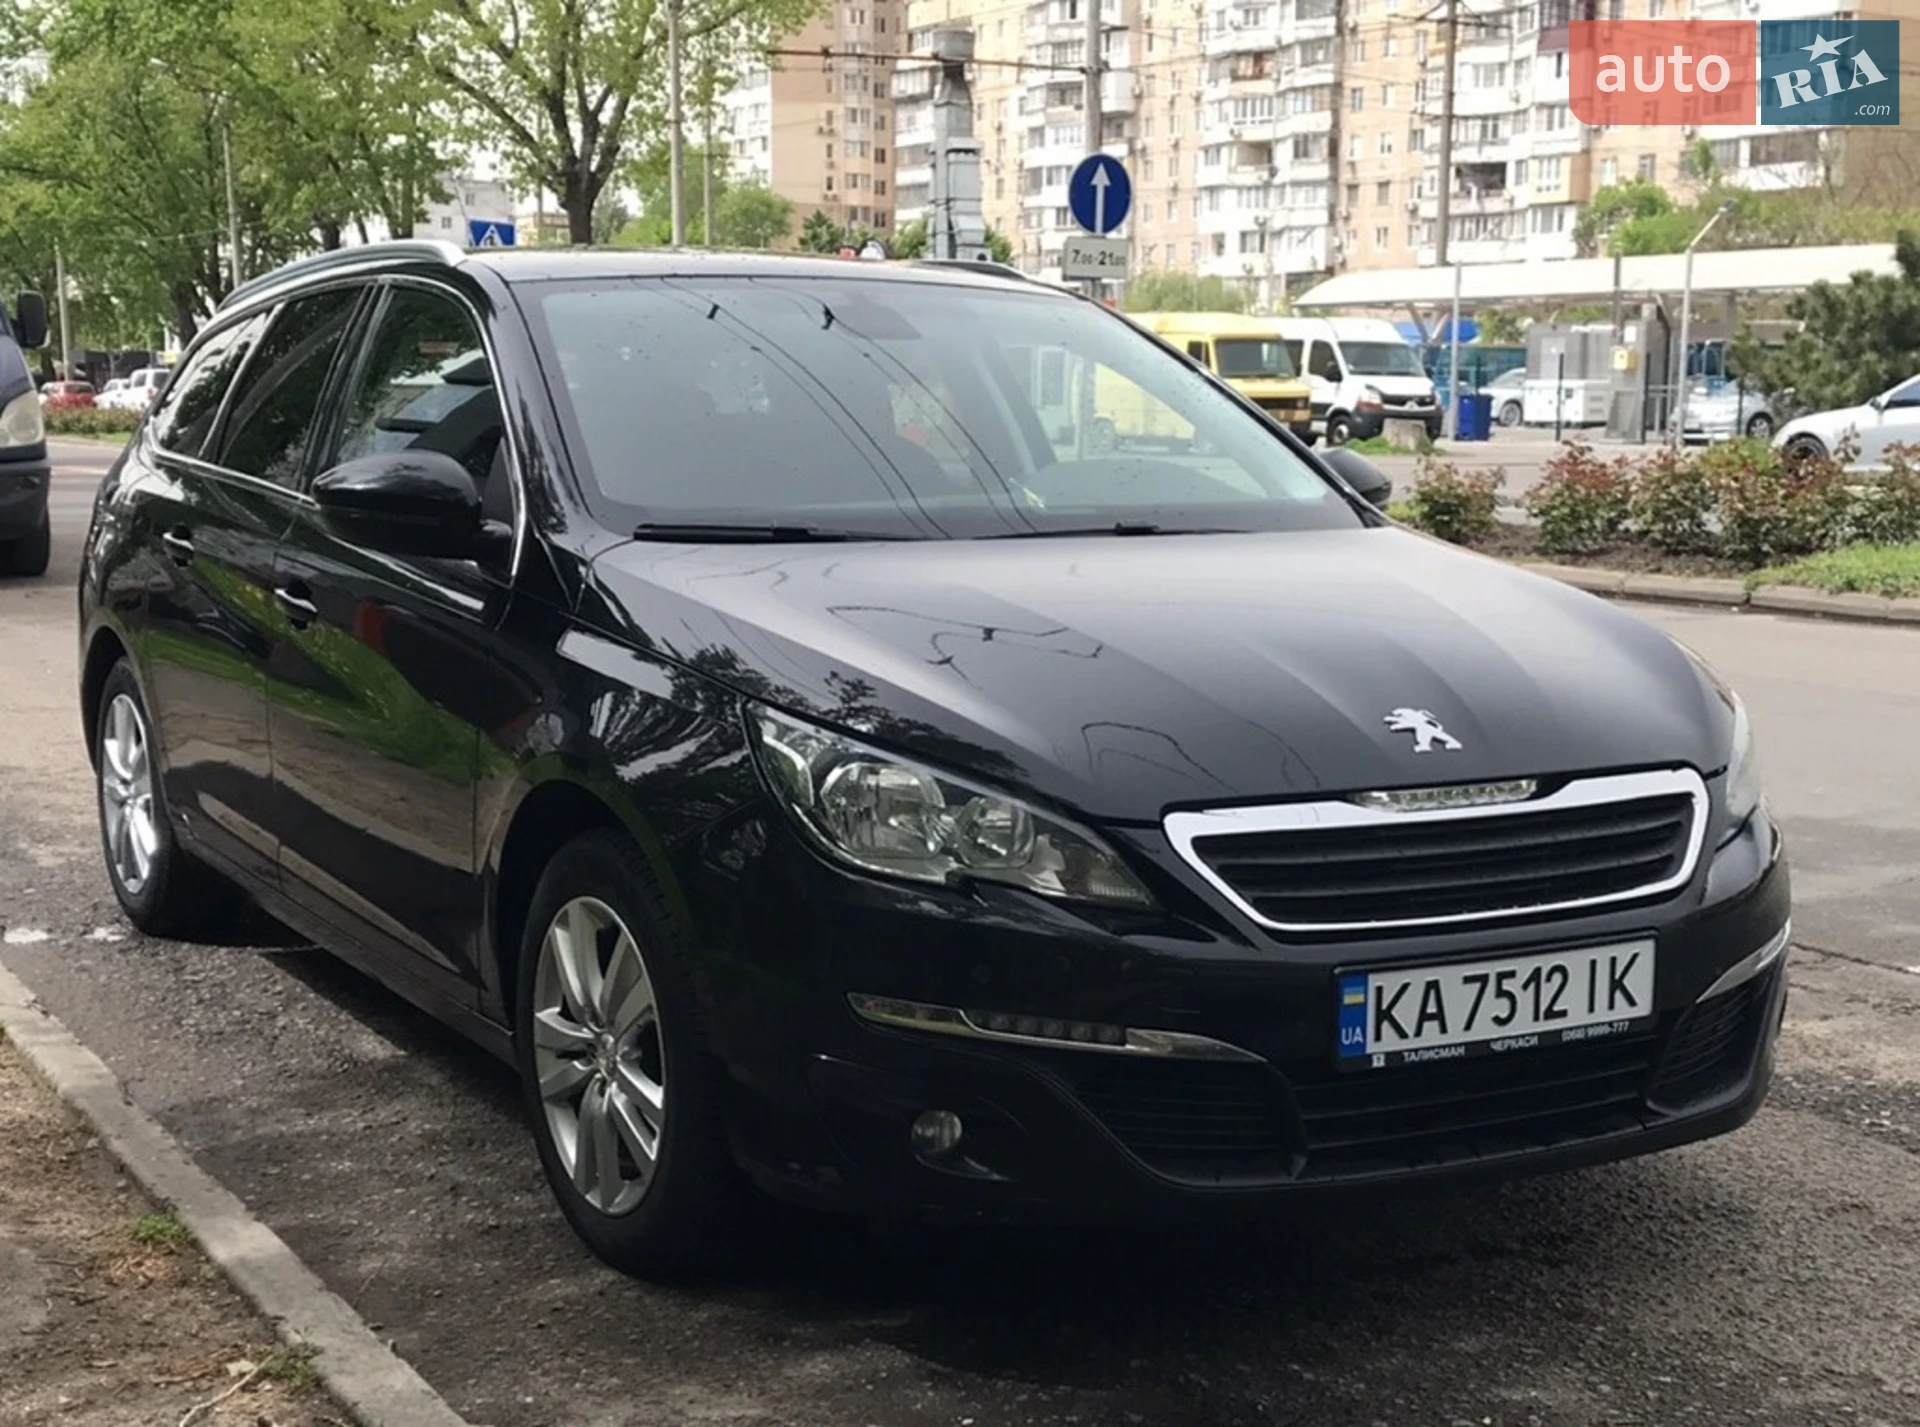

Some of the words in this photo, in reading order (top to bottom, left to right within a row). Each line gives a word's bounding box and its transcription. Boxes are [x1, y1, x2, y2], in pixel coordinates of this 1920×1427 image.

[1373, 979, 1448, 1043] KA
[1462, 963, 1570, 1032] 7512
[1587, 952, 1641, 1015] IK
[1341, 1026, 1364, 1045] UA
[1402, 1045, 1466, 1063] ТАЛИСМАН
[1489, 1034, 1539, 1051] ЧЕРКАСИ
